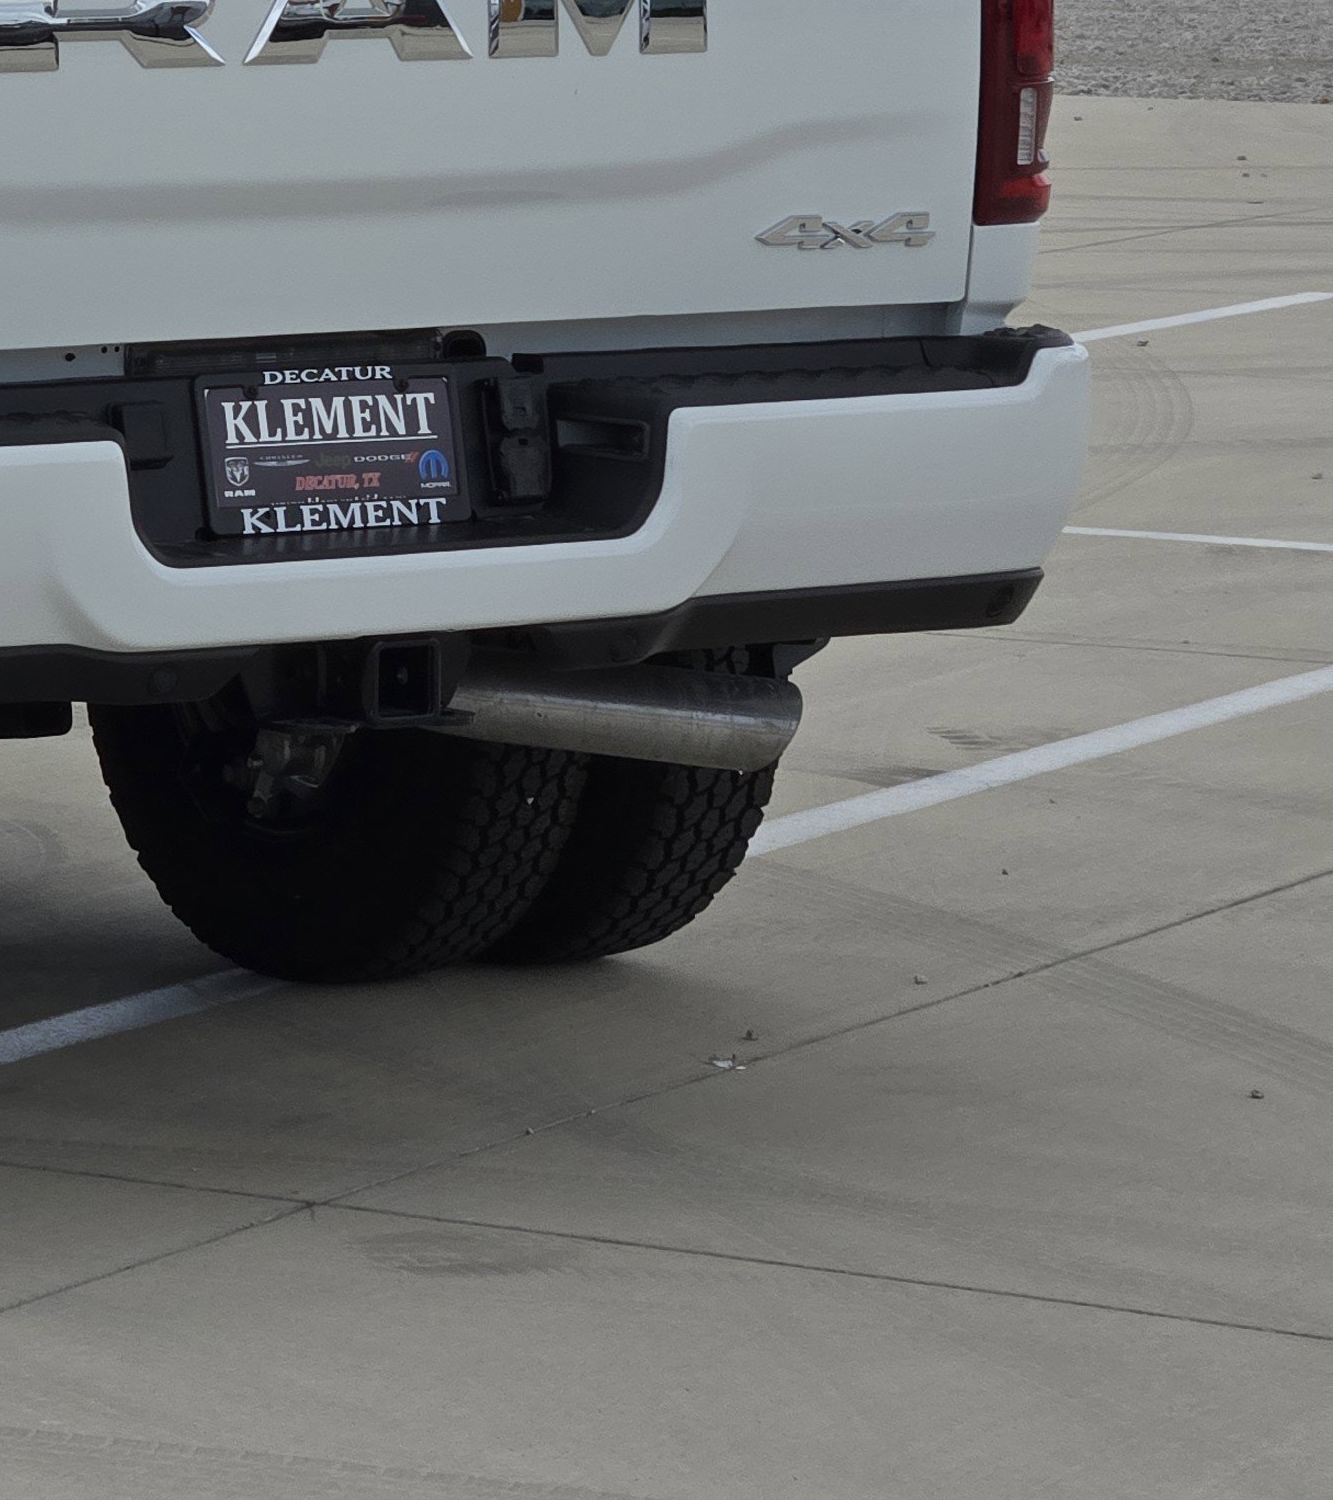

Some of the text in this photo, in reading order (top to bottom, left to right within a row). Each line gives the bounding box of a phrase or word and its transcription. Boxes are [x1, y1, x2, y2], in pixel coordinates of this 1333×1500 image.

[754, 211, 936, 250] 4x4
[262, 364, 393, 386] DECATUR
[220, 392, 436, 445] KLEMENT
[315, 453, 352, 469] Jeep
[353, 454, 413, 463] DODGE
[362, 472, 381, 488] TX
[224, 488, 256, 498] RAM
[240, 497, 447, 535] KLEMENT
